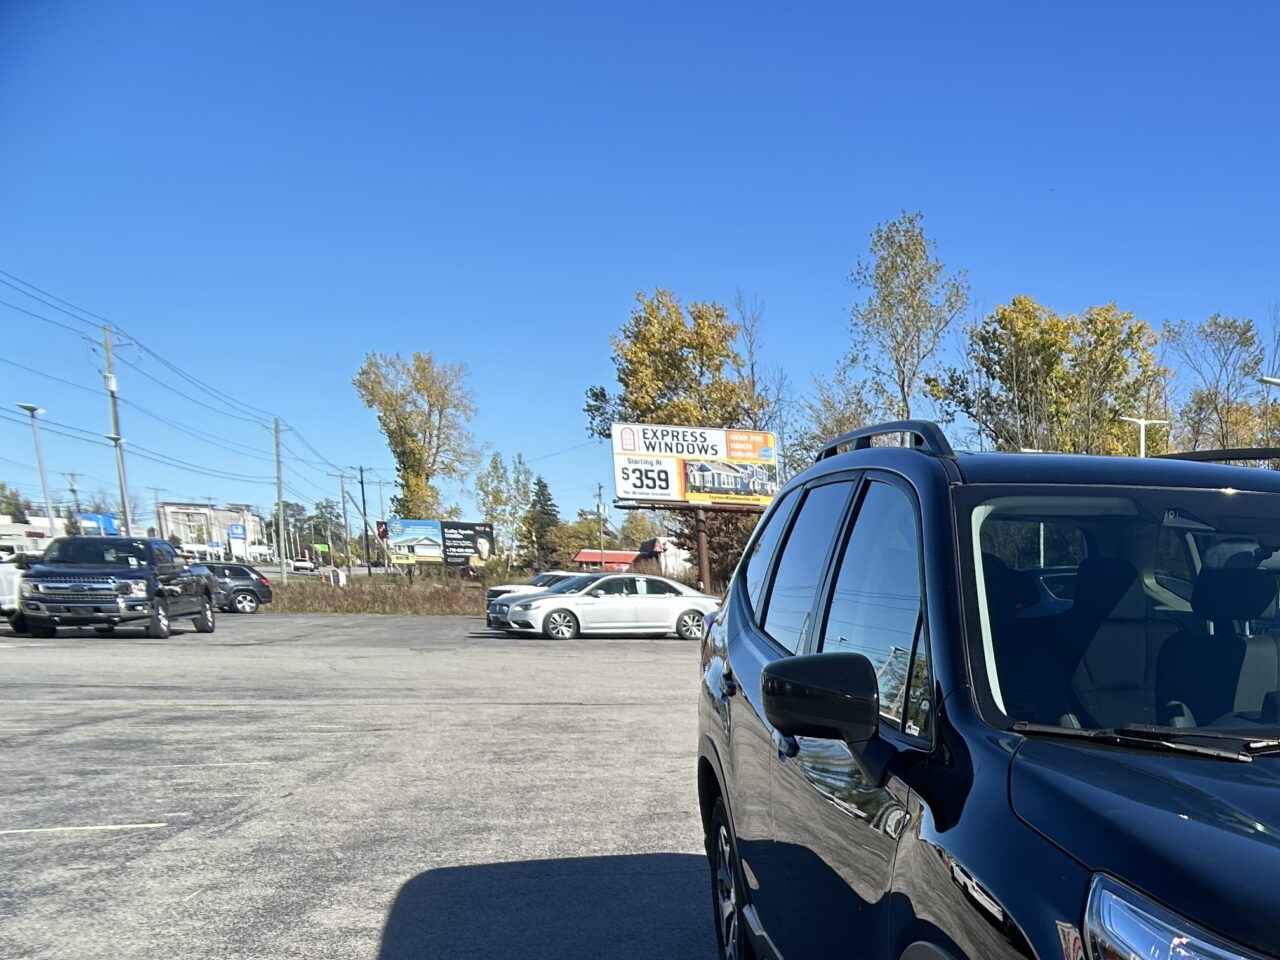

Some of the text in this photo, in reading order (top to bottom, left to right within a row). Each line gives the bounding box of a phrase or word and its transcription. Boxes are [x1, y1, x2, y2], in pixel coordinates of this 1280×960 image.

[642, 428, 707, 443] EXPRESS
[643, 441, 719, 456] WINDOWS
[627, 457, 654, 467] Starting
